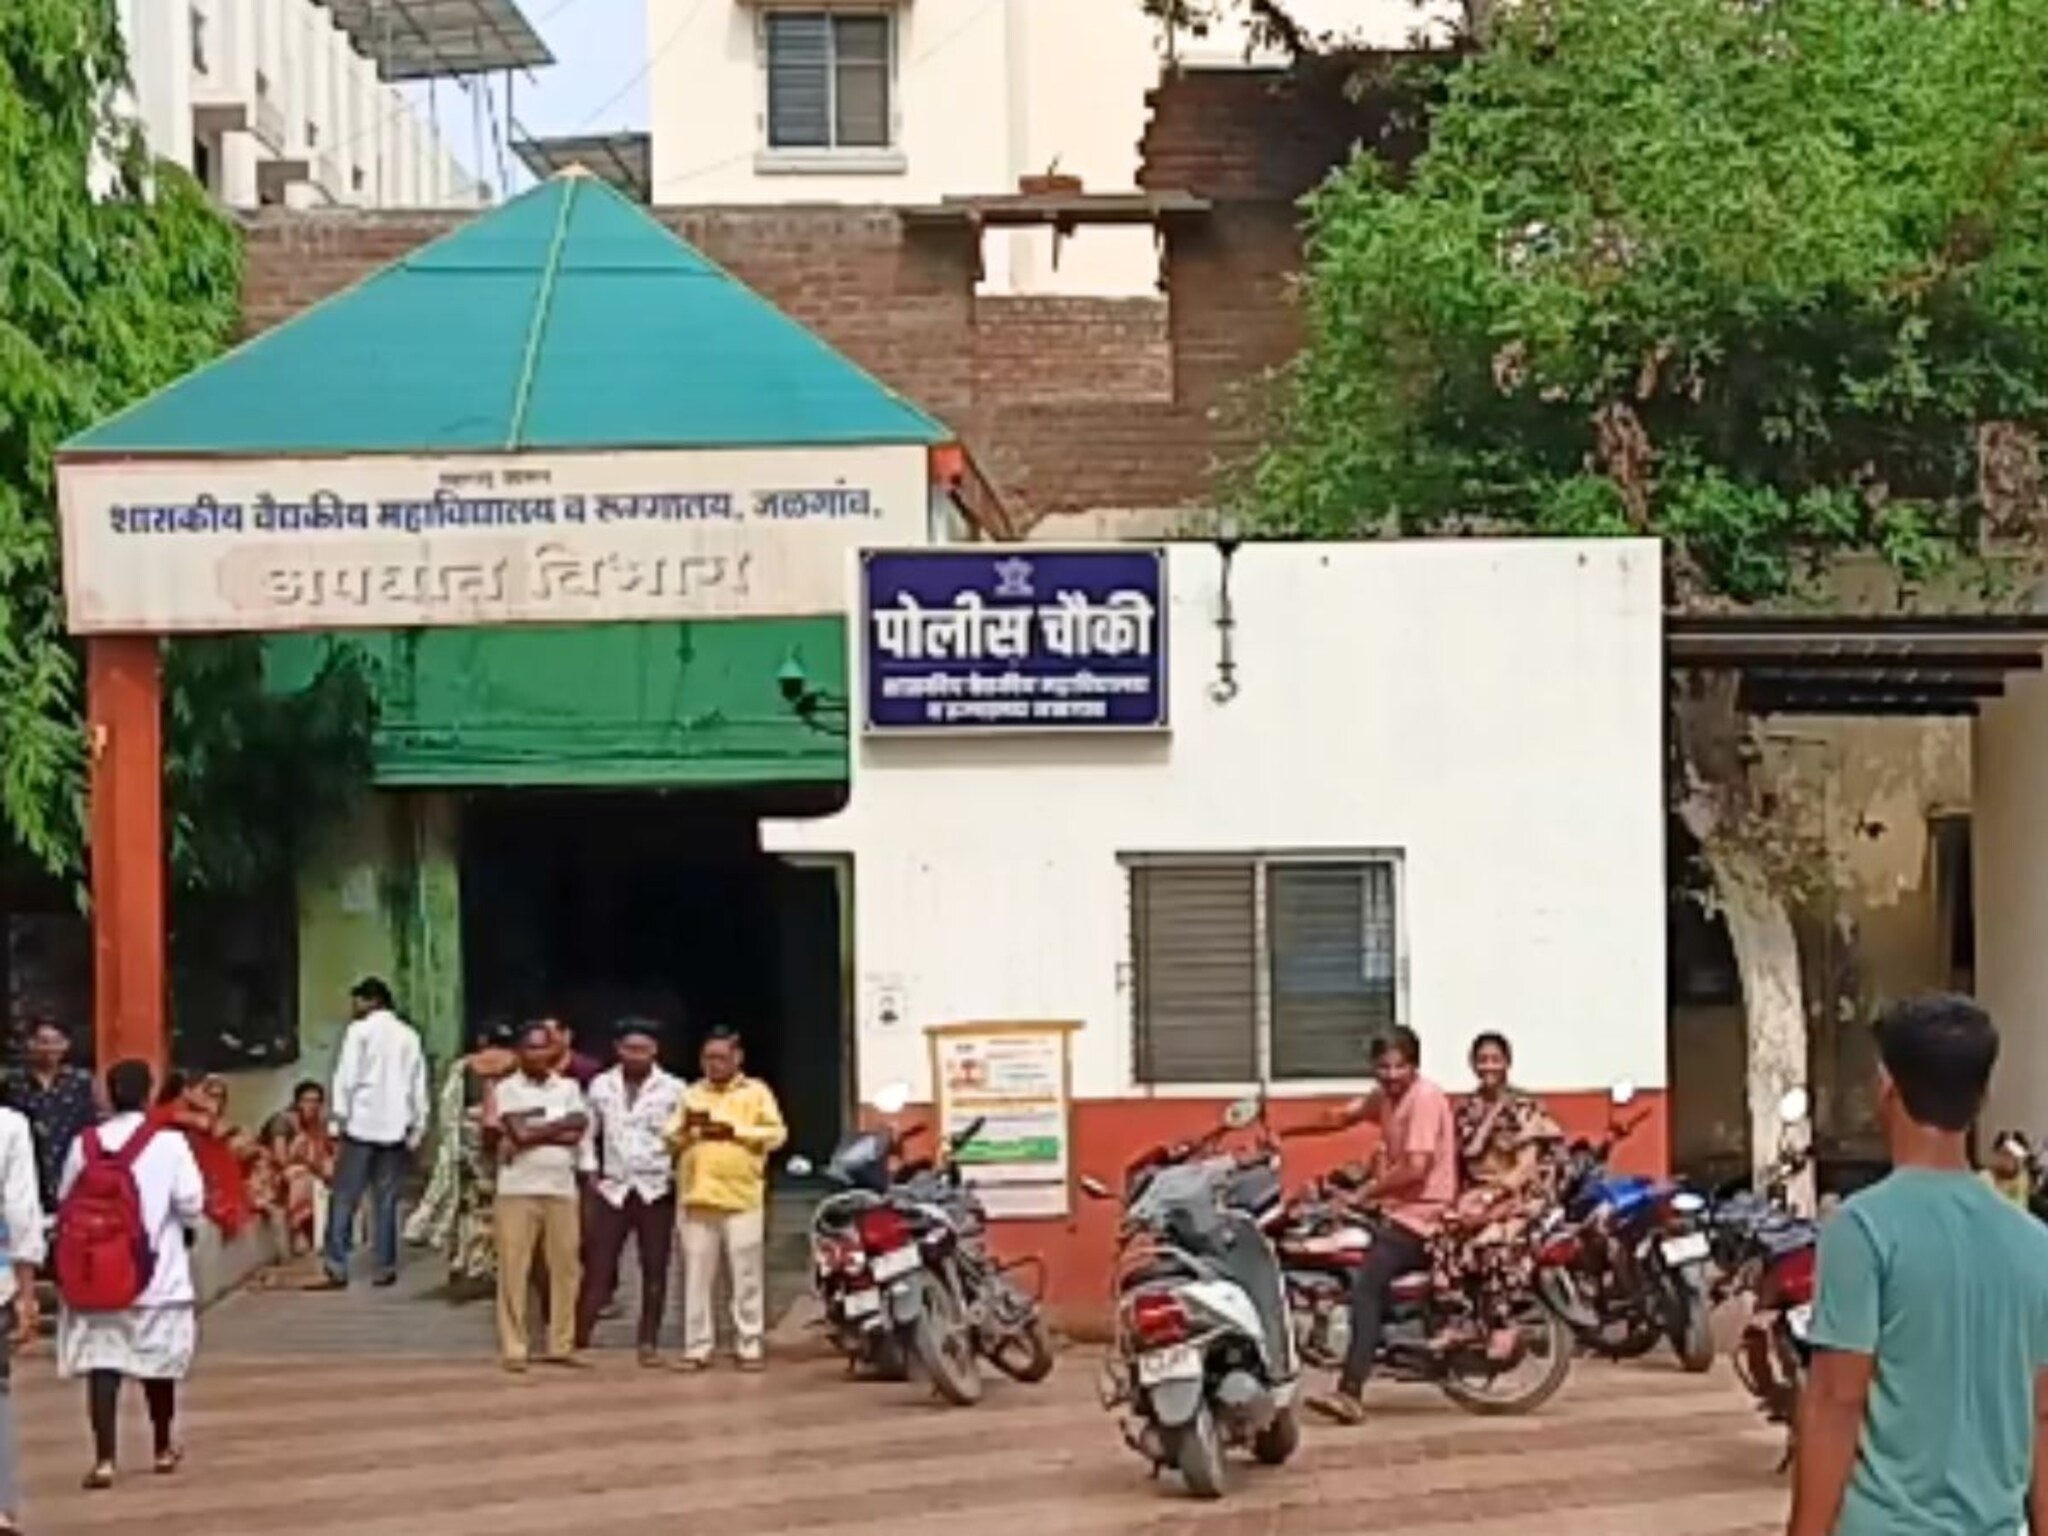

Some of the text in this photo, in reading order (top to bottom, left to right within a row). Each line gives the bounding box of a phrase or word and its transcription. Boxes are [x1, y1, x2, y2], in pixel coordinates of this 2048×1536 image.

[109, 492, 243, 534] शासकीय
[563, 495, 585, 524] व
[533, 541, 753, 599] विभाग
[873, 590, 1155, 659] पोलीस चौकी
